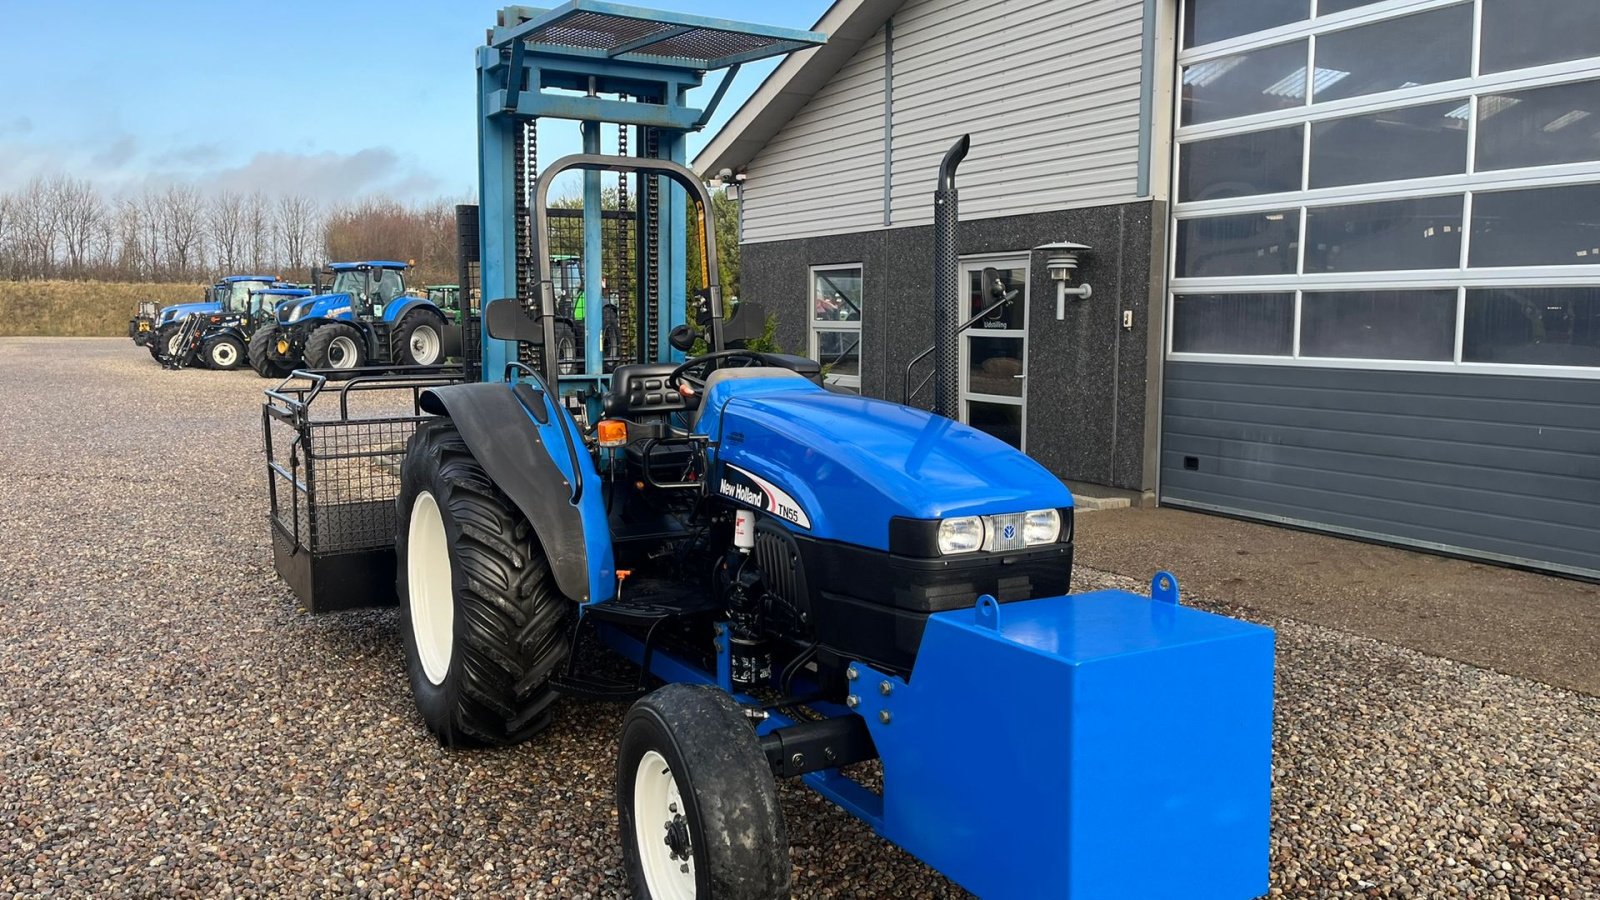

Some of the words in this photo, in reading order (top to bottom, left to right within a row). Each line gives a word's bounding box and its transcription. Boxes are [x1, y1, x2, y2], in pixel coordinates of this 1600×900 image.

[720, 478, 735, 497] New
[735, 484, 762, 507] Holland
[778, 503, 798, 522] TN55
